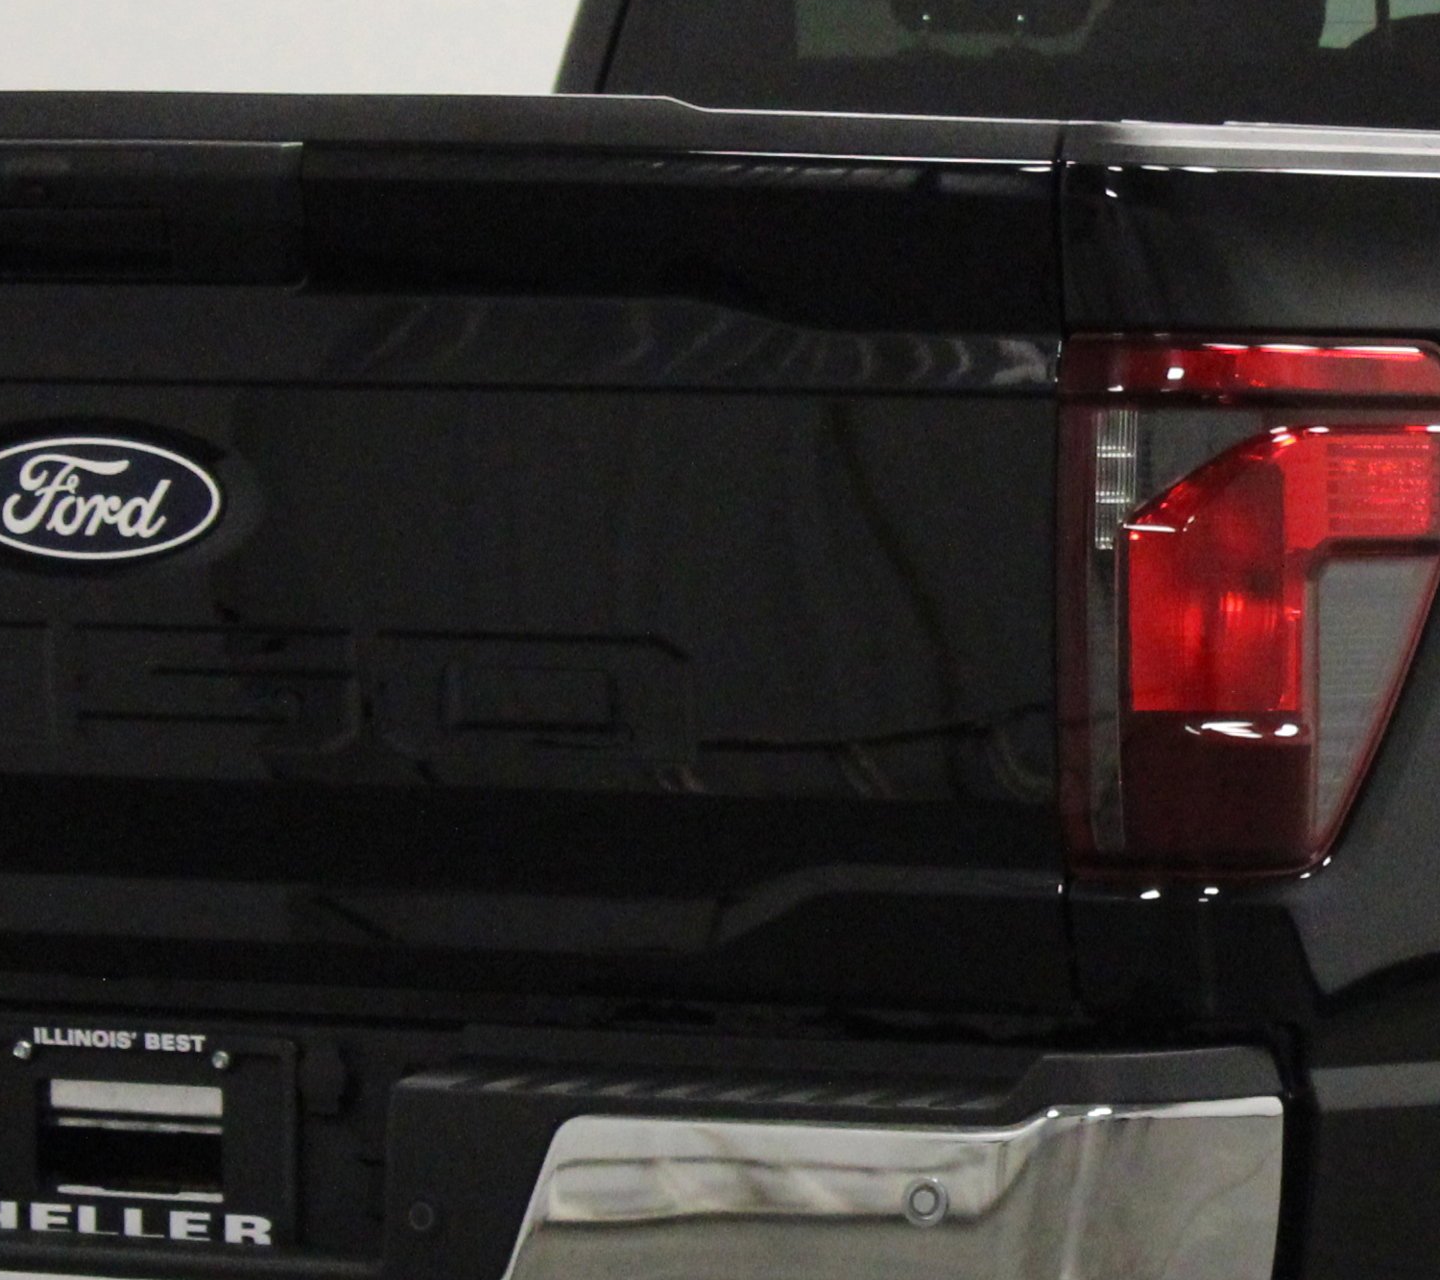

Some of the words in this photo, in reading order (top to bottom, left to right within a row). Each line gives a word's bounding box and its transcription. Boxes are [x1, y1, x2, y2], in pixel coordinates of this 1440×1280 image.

[2, 453, 172, 539] Ford
[33, 1026, 137, 1050] ILLINOIS'
[144, 1032, 206, 1053] BEST
